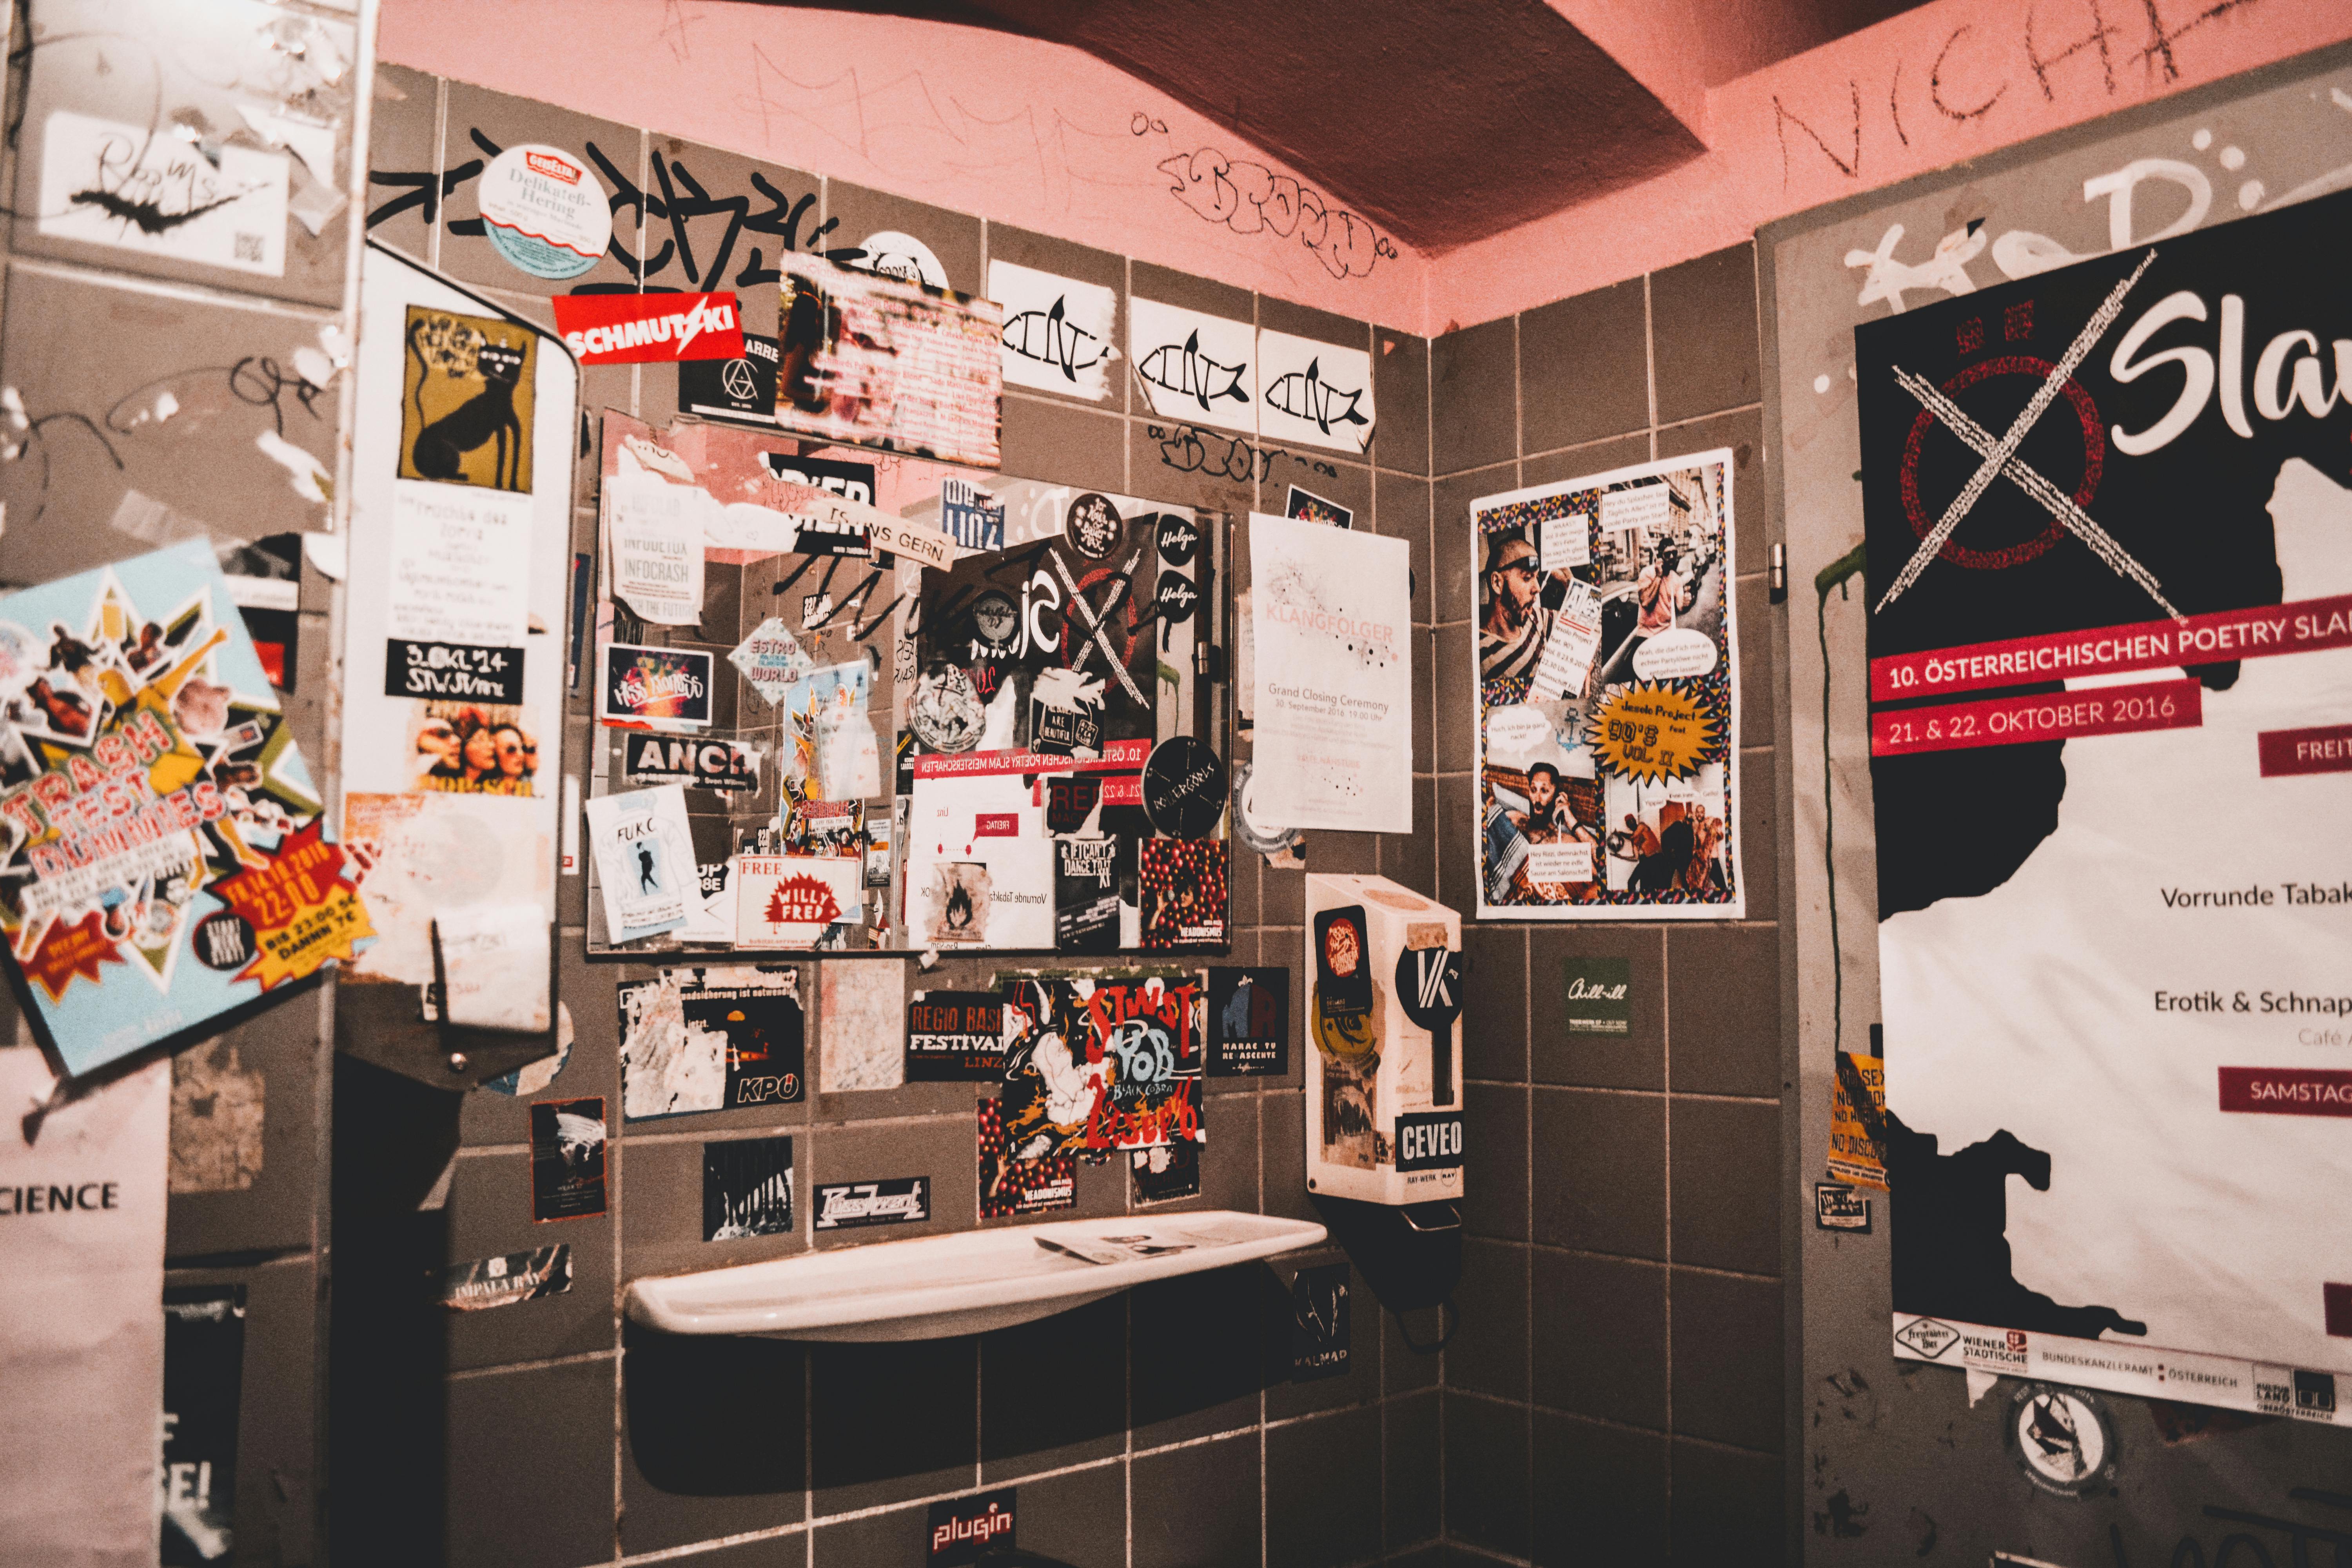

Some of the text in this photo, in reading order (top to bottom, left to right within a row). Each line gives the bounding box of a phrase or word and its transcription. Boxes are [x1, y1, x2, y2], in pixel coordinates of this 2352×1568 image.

[509, 167, 591, 206] Delikateß-
[521, 187, 575, 220] Hering
[565, 295, 736, 358] SCHMUTZKI
[1603, 499, 1616, 508] Hey
[1622, 515, 1639, 526] Party
[898, 532, 944, 562] GERN
[1161, 526, 1198, 551] Helga
[625, 558, 689, 583] INFOCRASH
[1160, 583, 1198, 608] Helga
[1265, 602, 1394, 644] KLANGFOLGER
[1572, 632, 1593, 646] Project
[1639, 648, 1653, 657] Yeah,
[1666, 644, 1678, 653] darf
[1889, 611, 2352, 690] 10. ÖSTERREICHISCHEN POETRY SLA
[1557, 664, 1568, 674] Uhr
[1641, 658, 1659, 667] echter
[1660, 654, 1691, 666] Partylöwe
[750, 666, 799, 682] WORLD
[1537, 670, 1568, 688] Salonschiff
[1649, 668, 1678, 677] entgehen
[1269, 683, 1389, 714] Grand Closing Ceremony
[1533, 681, 1562, 699] Florentine
[1276, 699, 1286, 708] 30.
[1288, 701, 1326, 714] September
[1327, 707, 1345, 717] 2016
[1370, 713, 1383, 722] Uhr
[1655, 704, 1696, 722] Project
[1889, 694, 2177, 745] 21. & 22. OKTOBER 2016
[1052, 715, 1065, 728] ARE
[1533, 722, 1546, 731] ganz
[1530, 849, 1589, 860] Hey demnächst
[742, 862, 782, 875] FREE
[1064, 859, 1090, 876] DANCE
[777, 888, 829, 903] WILLY
[2160, 885, 2274, 908] Vorrunde
[681, 989, 738, 1001] undsicherung
[2155, 991, 2352, 1018] Erotik & Schnap
[912, 1006, 1003, 1033] REGIO BASI
[2298, 1028, 2342, 1047] Café
[964, 1057, 1003, 1069] LINZ
[737, 1073, 799, 1103] KPÖ
[1113, 1083, 1173, 1102] BLACK COBRA
[2250, 1081, 2352, 1103] SAMSTAG
[1831, 1133, 1846, 1152] NO
[1962, 1336, 2006, 1351] WIENER
[2042, 1351, 2238, 1388] BUNDESKANZLERAMT ÖSTERREICH
[2256, 1382, 2291, 1392] KULTUR
[2256, 1390, 2291, 1403] LAND
[933, 1502, 1013, 1550] plugin
